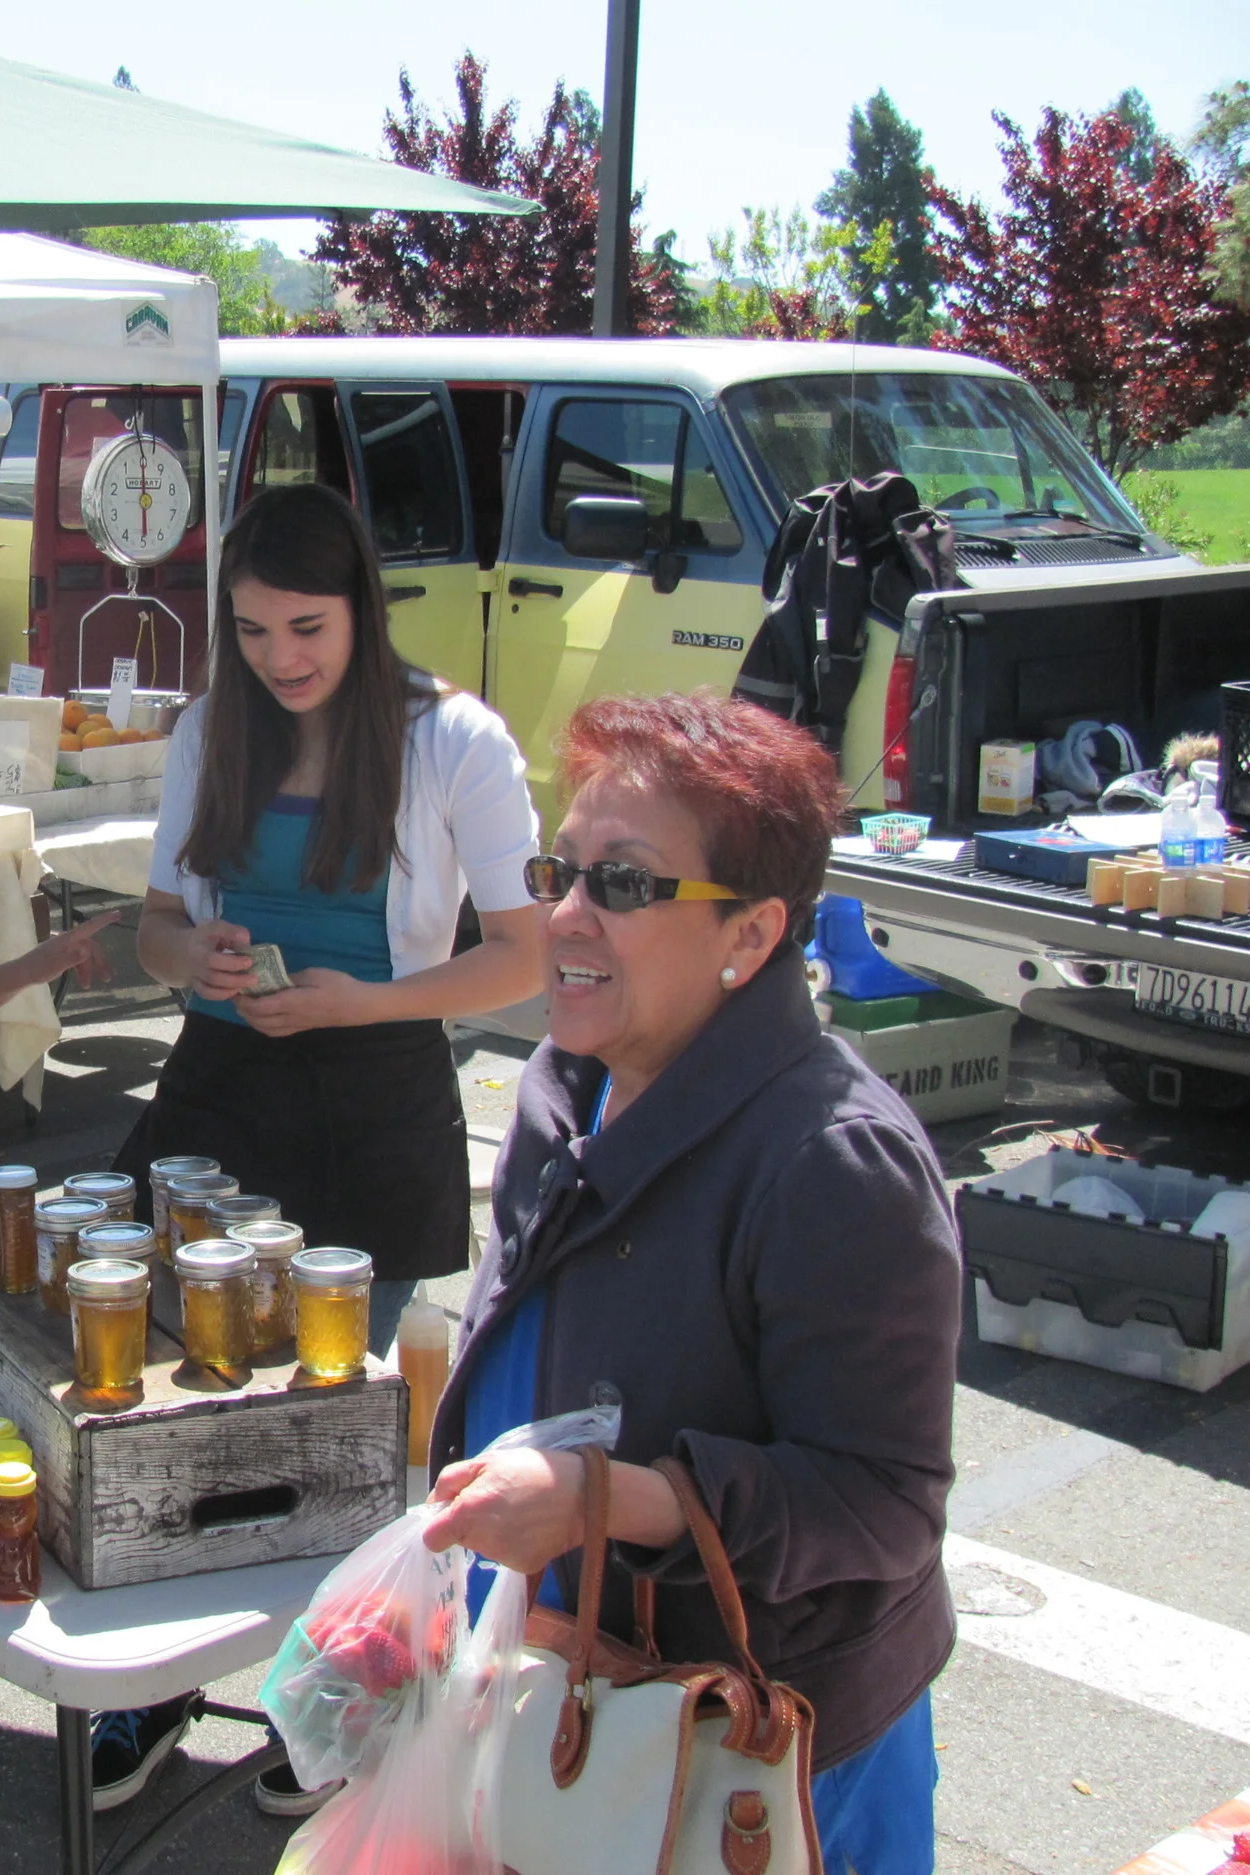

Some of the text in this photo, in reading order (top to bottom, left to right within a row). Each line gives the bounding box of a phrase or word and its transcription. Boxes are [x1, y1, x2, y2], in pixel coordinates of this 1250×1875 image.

[157, 463, 165, 476] 9
[110, 483, 118, 496] 2
[168, 483, 176, 496] 8
[110, 508, 118, 521] 3
[169, 508, 177, 521] 7
[121, 528, 129, 542] 4
[156, 528, 164, 541] 6
[140, 535, 147, 548] 5
[672, 630, 742, 650] RAM 350
[951, 1056, 999, 1089] KING
